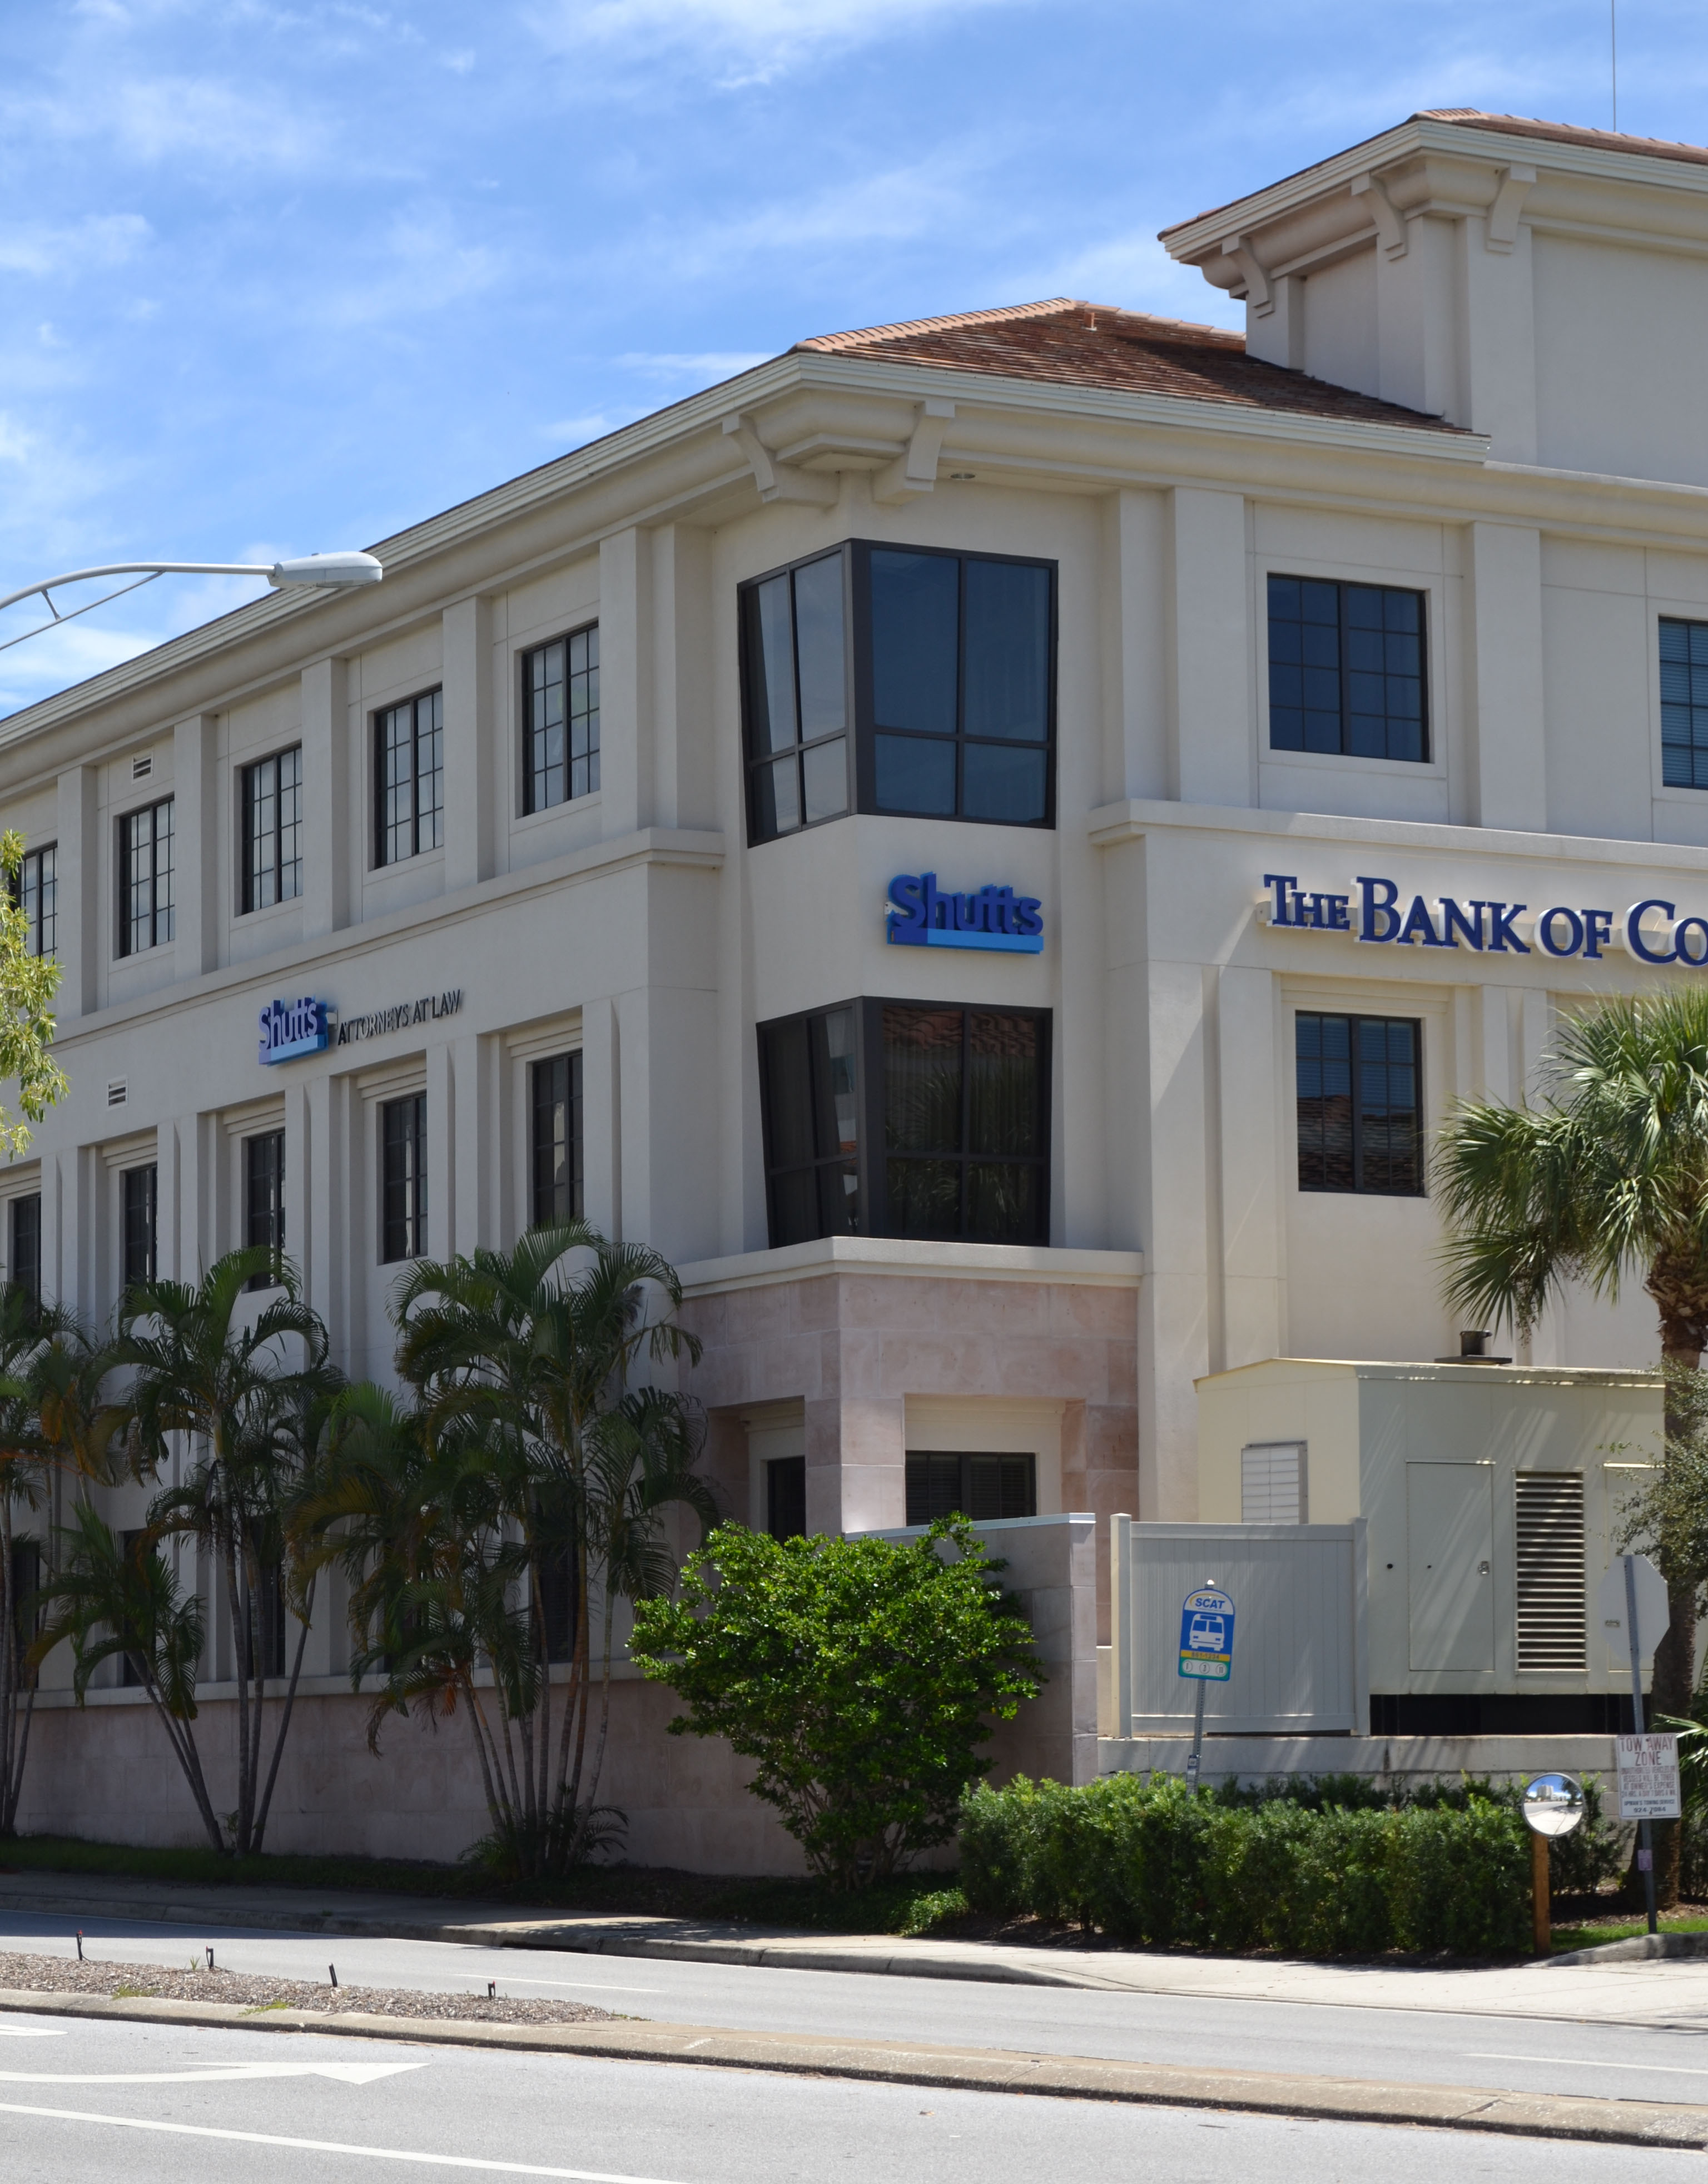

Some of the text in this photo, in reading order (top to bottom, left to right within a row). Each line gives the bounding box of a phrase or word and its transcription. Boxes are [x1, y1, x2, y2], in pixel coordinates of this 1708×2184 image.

[888, 871, 1044, 936] Shutts
[1263, 873, 1350, 931] THE
[1352, 876, 1531, 955] BANK
[1536, 906, 1613, 960] OF
[259, 997, 321, 1051] Shutts
[337, 989, 460, 1045] ATTORNEYS AT LAW
[1195, 1597, 1225, 1610] SCAT
[1620, 1735, 1673, 1752] TOW AWAY
[1635, 1751, 1661, 1766] ZONE
